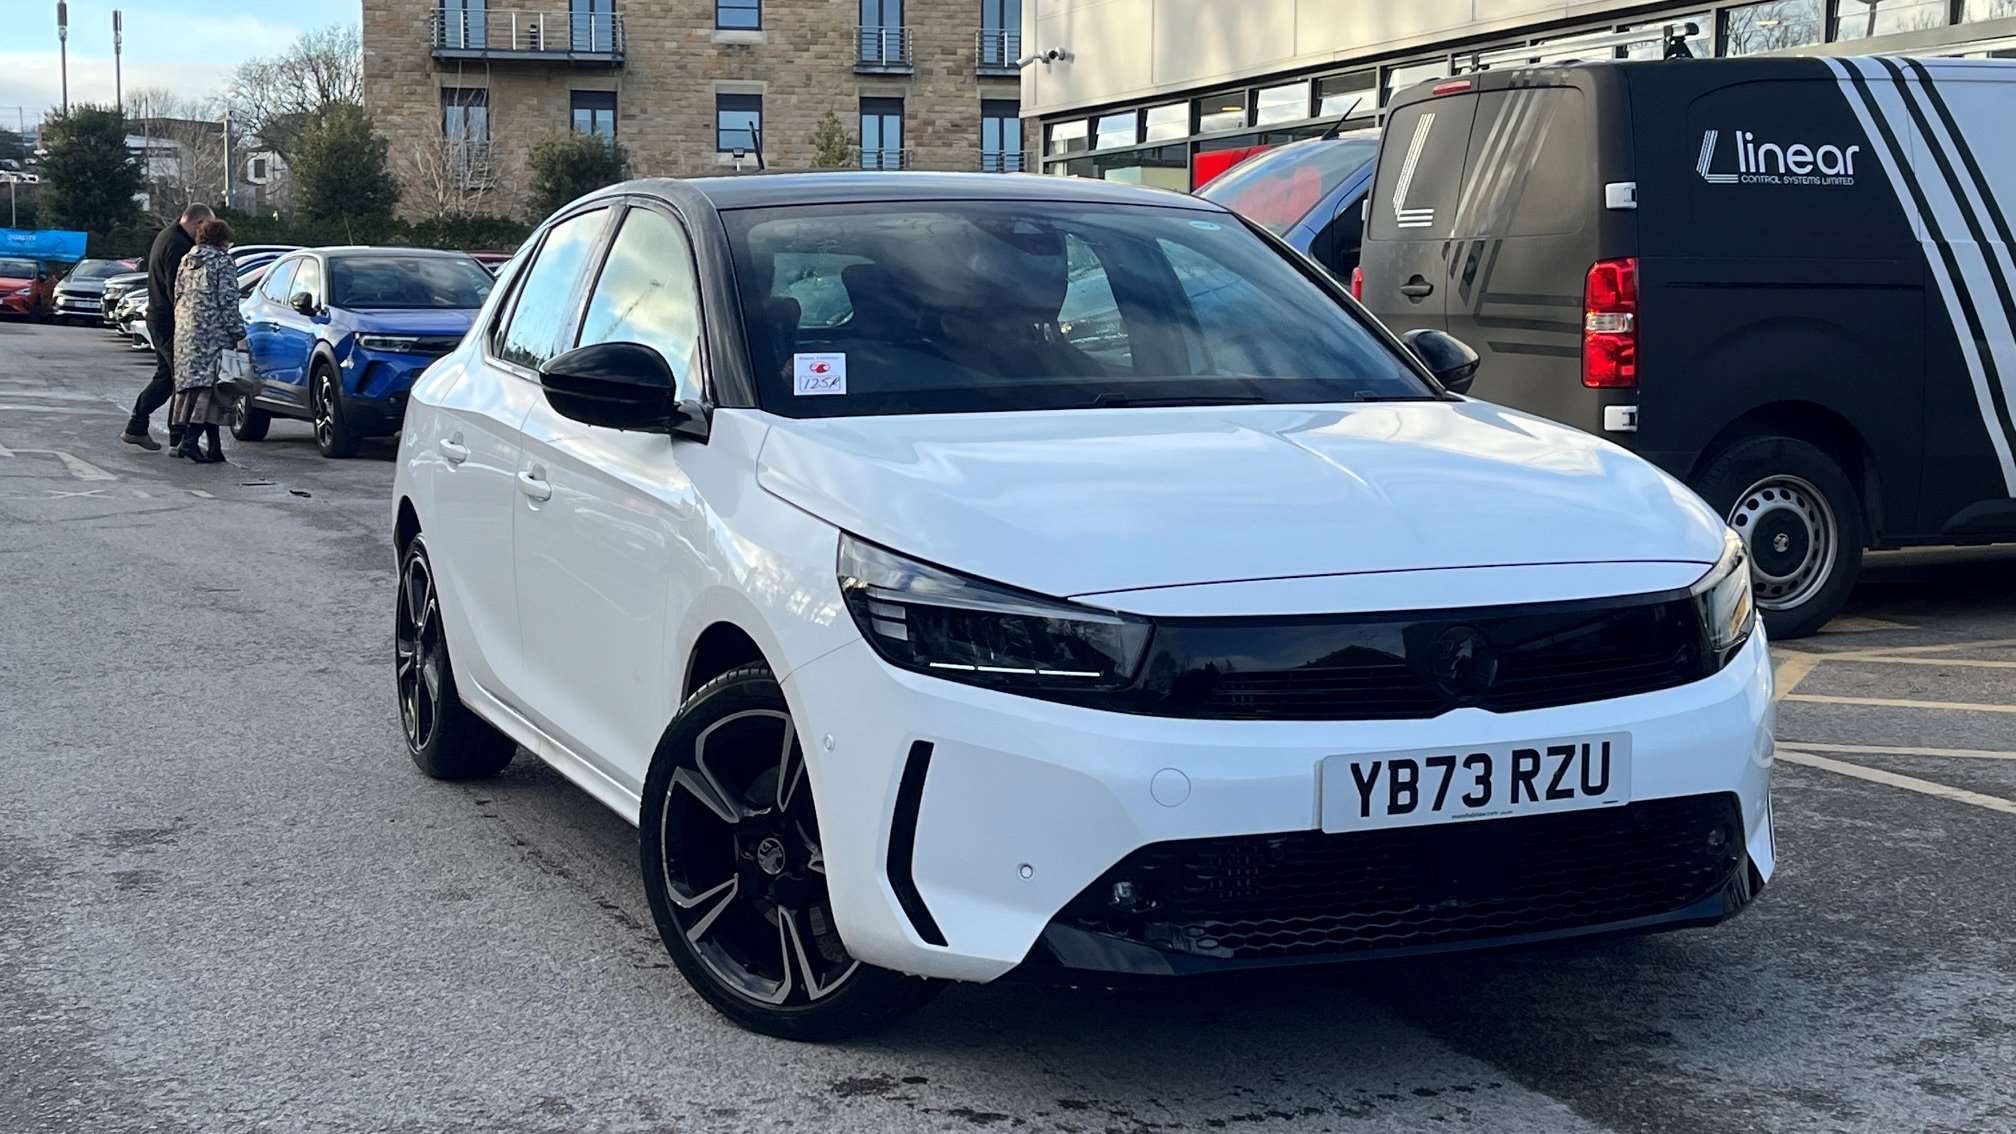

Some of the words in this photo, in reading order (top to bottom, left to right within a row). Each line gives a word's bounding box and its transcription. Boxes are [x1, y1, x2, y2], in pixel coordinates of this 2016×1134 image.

[1736, 130, 1860, 175] linear
[1740, 174, 1781, 184] CONTROL
[1783, 175, 1820, 185] SYSTEMS
[1821, 176, 1855, 186] LIMITED
[1350, 752, 1493, 818] YB73
[1510, 741, 1611, 804] RZU
